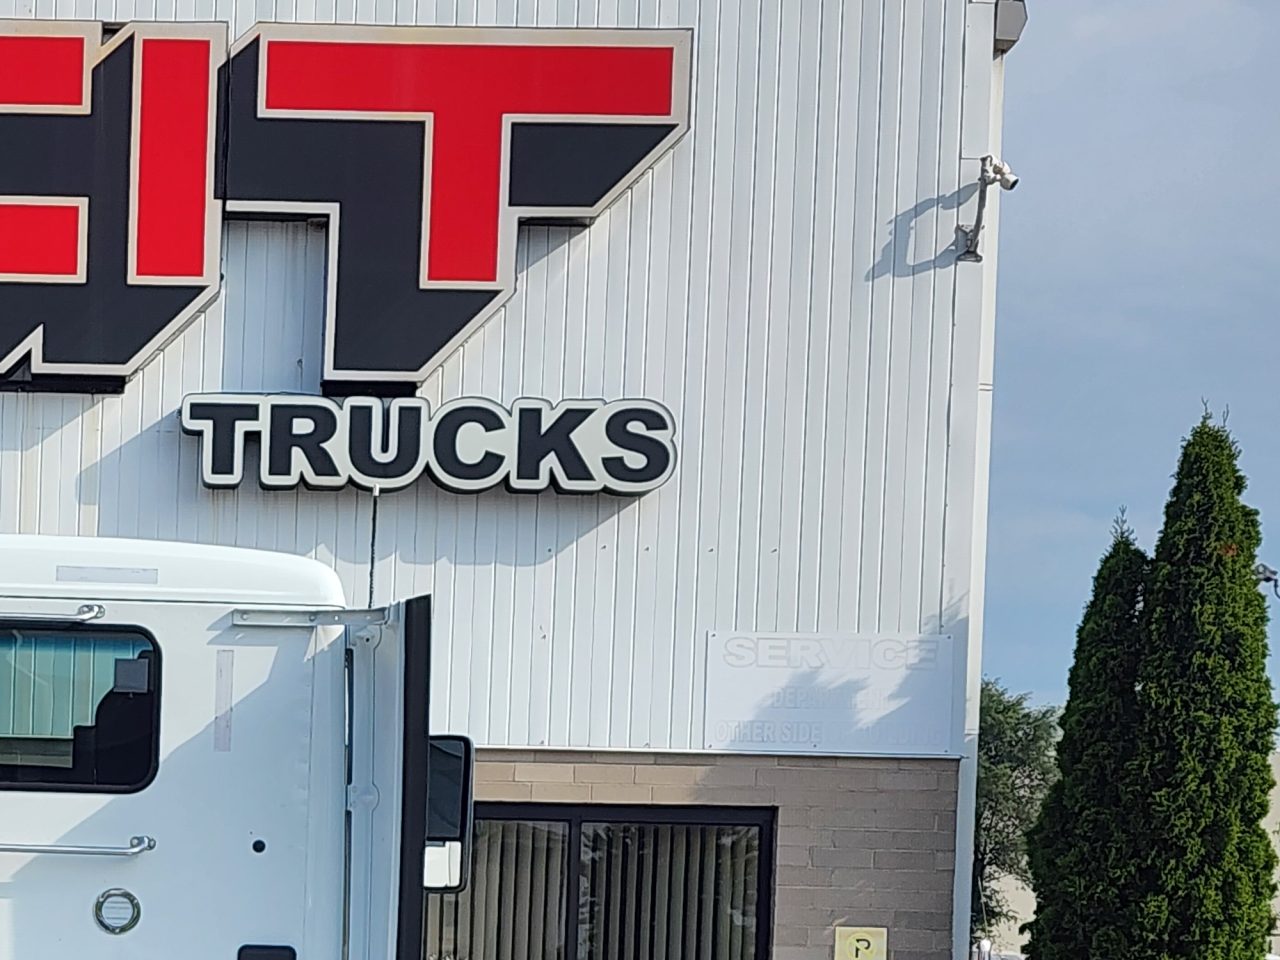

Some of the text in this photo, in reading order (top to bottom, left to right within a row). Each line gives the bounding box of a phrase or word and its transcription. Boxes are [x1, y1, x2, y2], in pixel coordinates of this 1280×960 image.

[184, 397, 675, 491] TRUCKS
[723, 636, 939, 670] SERVICE
[715, 720, 775, 743] OTHER
[780, 721, 823, 744] SIDE
